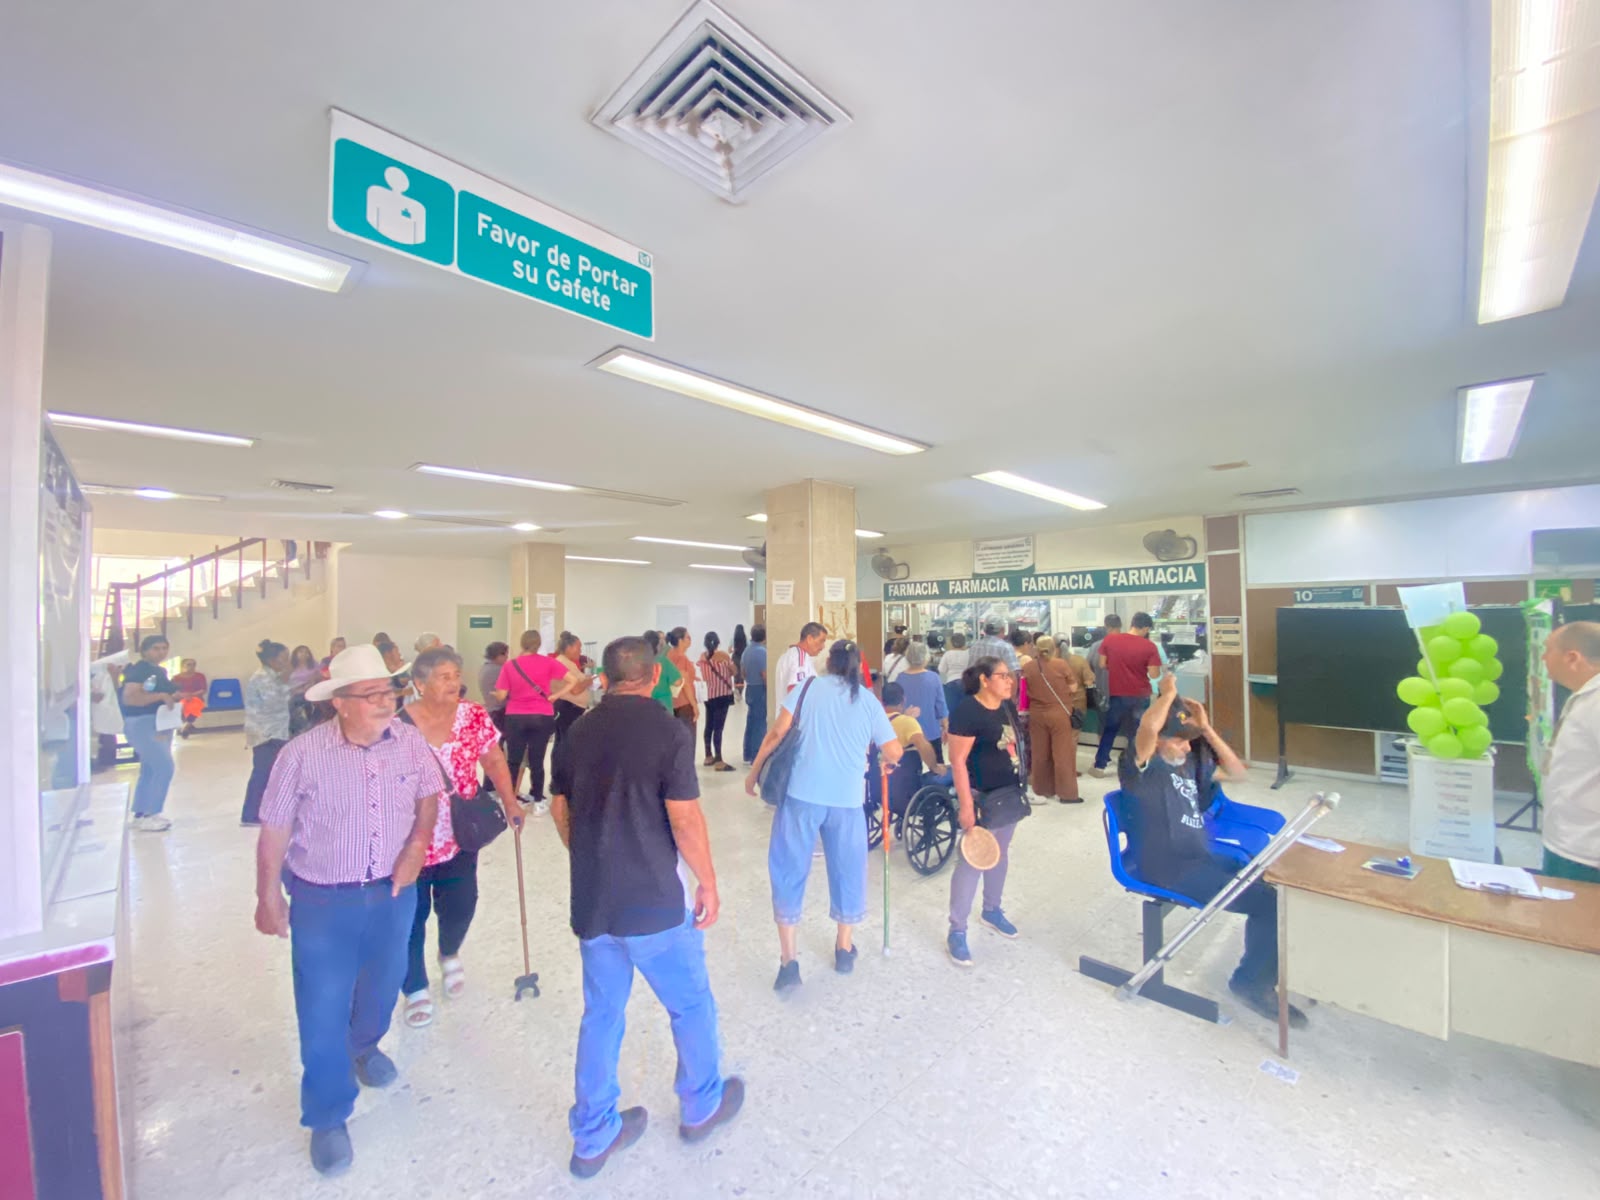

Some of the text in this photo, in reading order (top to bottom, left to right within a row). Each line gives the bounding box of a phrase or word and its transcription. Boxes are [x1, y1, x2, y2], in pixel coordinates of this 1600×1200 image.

[477, 211, 638, 297] Favor de Portar
[512, 260, 611, 311] su Gafete
[888, 566, 1197, 597] FARMACIA FARMACIA FARMACIA FARMACIA
[1294, 590, 1313, 602] 10
